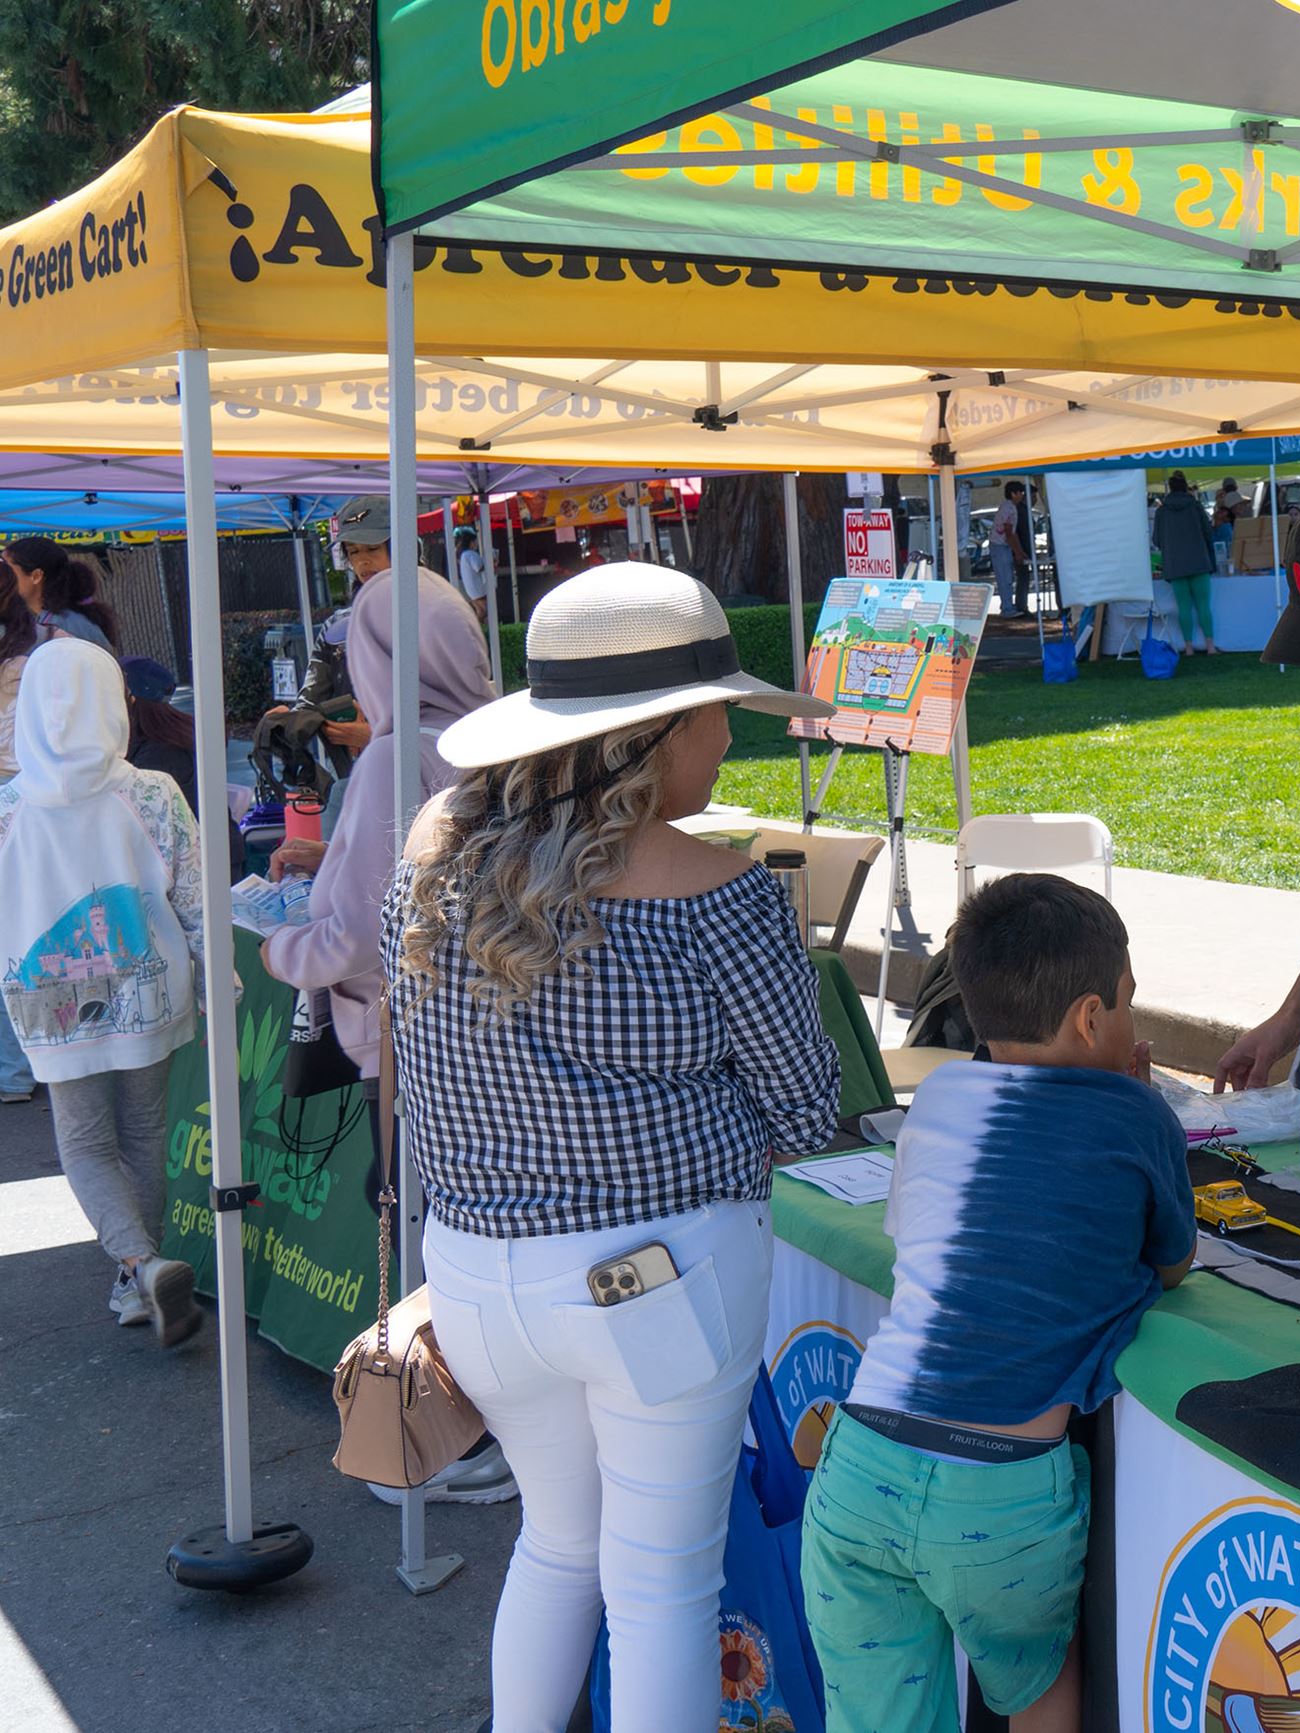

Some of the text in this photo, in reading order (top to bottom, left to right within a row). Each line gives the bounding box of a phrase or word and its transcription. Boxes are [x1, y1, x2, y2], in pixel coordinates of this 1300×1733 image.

[8, 244, 73, 307] Green
[79, 190, 147, 282] Cart!
[848, 558, 892, 574] PARKING
[180, 1203, 216, 1238] gree
[307, 1262, 364, 1313] world
[788, 1355, 808, 1407] of
[858, 1411, 879, 1422] FRUIT
[950, 1433, 977, 1446] FRUIT
[986, 1440, 1014, 1453] LOOM
[725, 1613, 743, 1624] WE
[760, 1638, 770, 1654] UP
[1164, 1593, 1209, 1730] CITY
[1205, 1540, 1238, 1609] of
